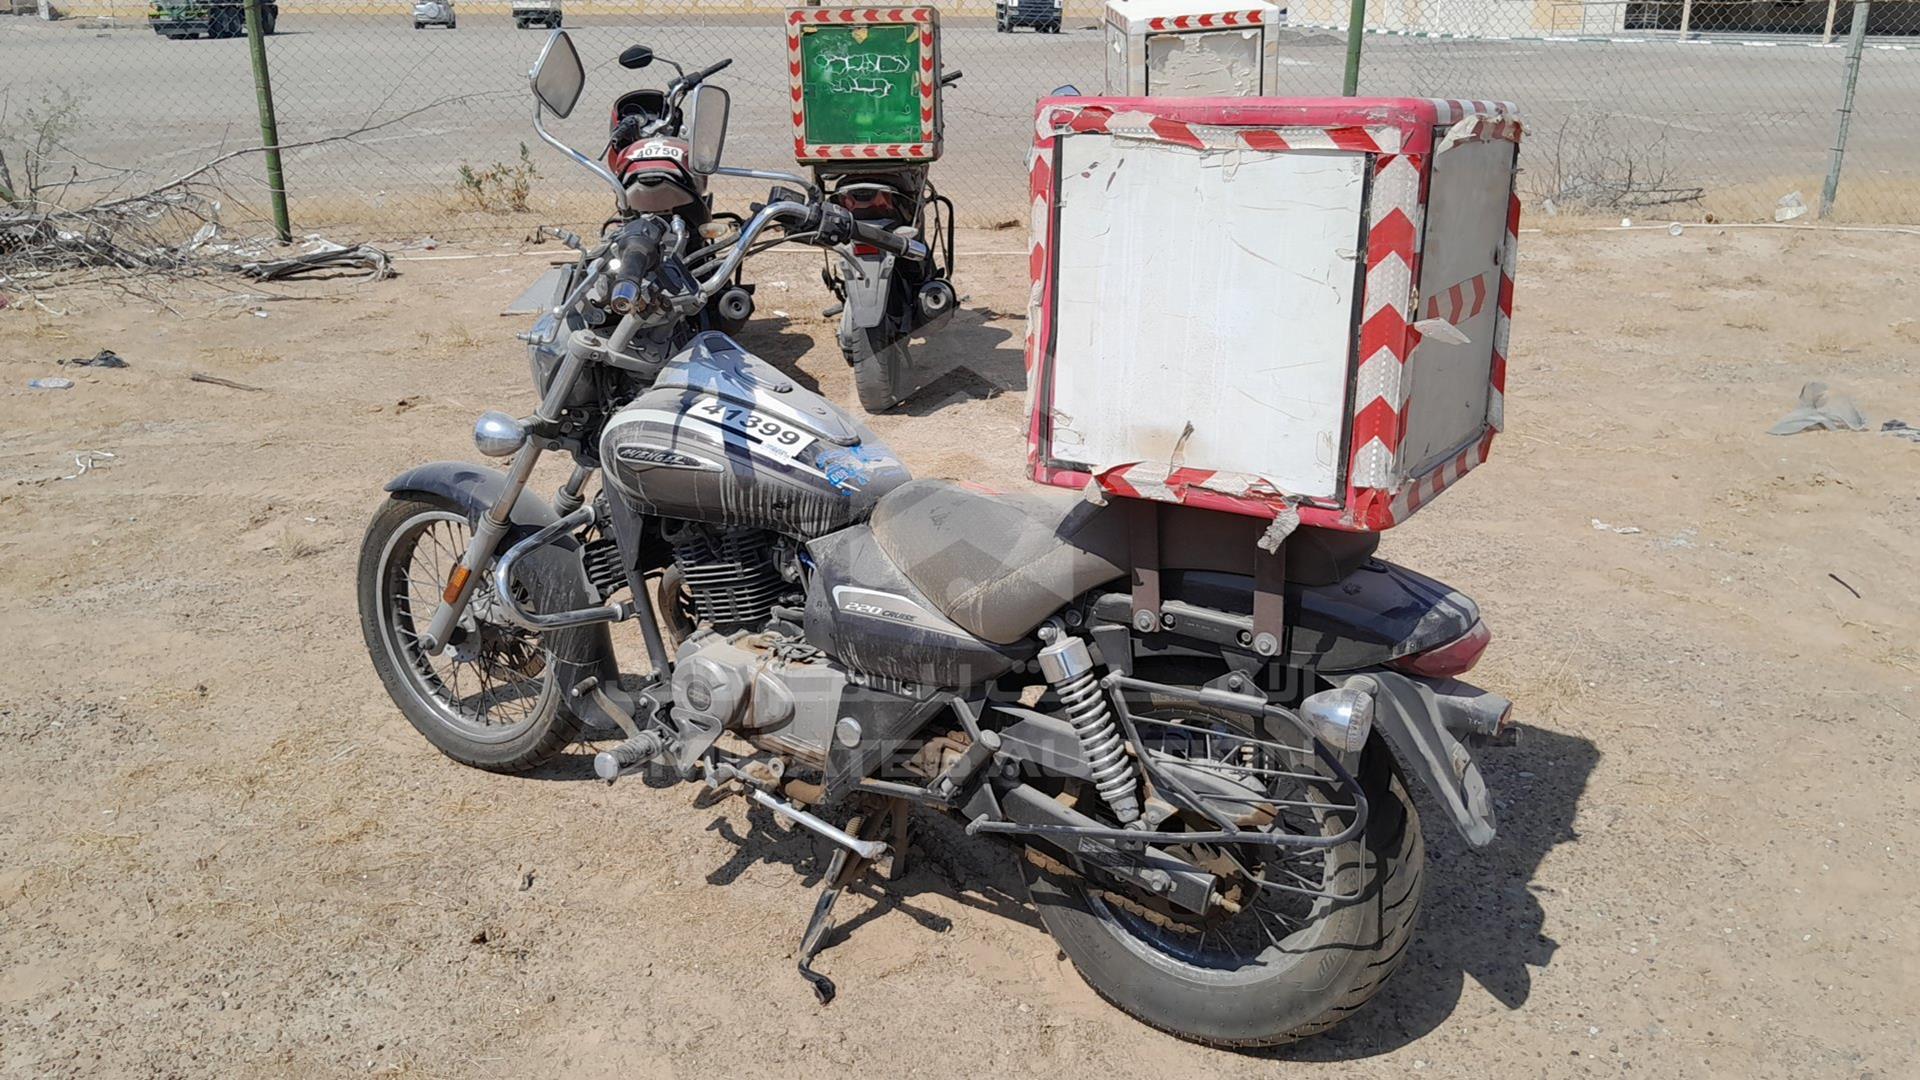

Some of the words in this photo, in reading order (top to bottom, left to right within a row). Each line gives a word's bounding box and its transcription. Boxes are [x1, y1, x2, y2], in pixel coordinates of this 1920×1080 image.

[637, 147, 679, 158] 40750
[701, 404, 800, 445] 41399
[620, 448, 685, 465] AVENGER
[845, 601, 883, 615] 220
[882, 610, 918, 622] CRUISE
